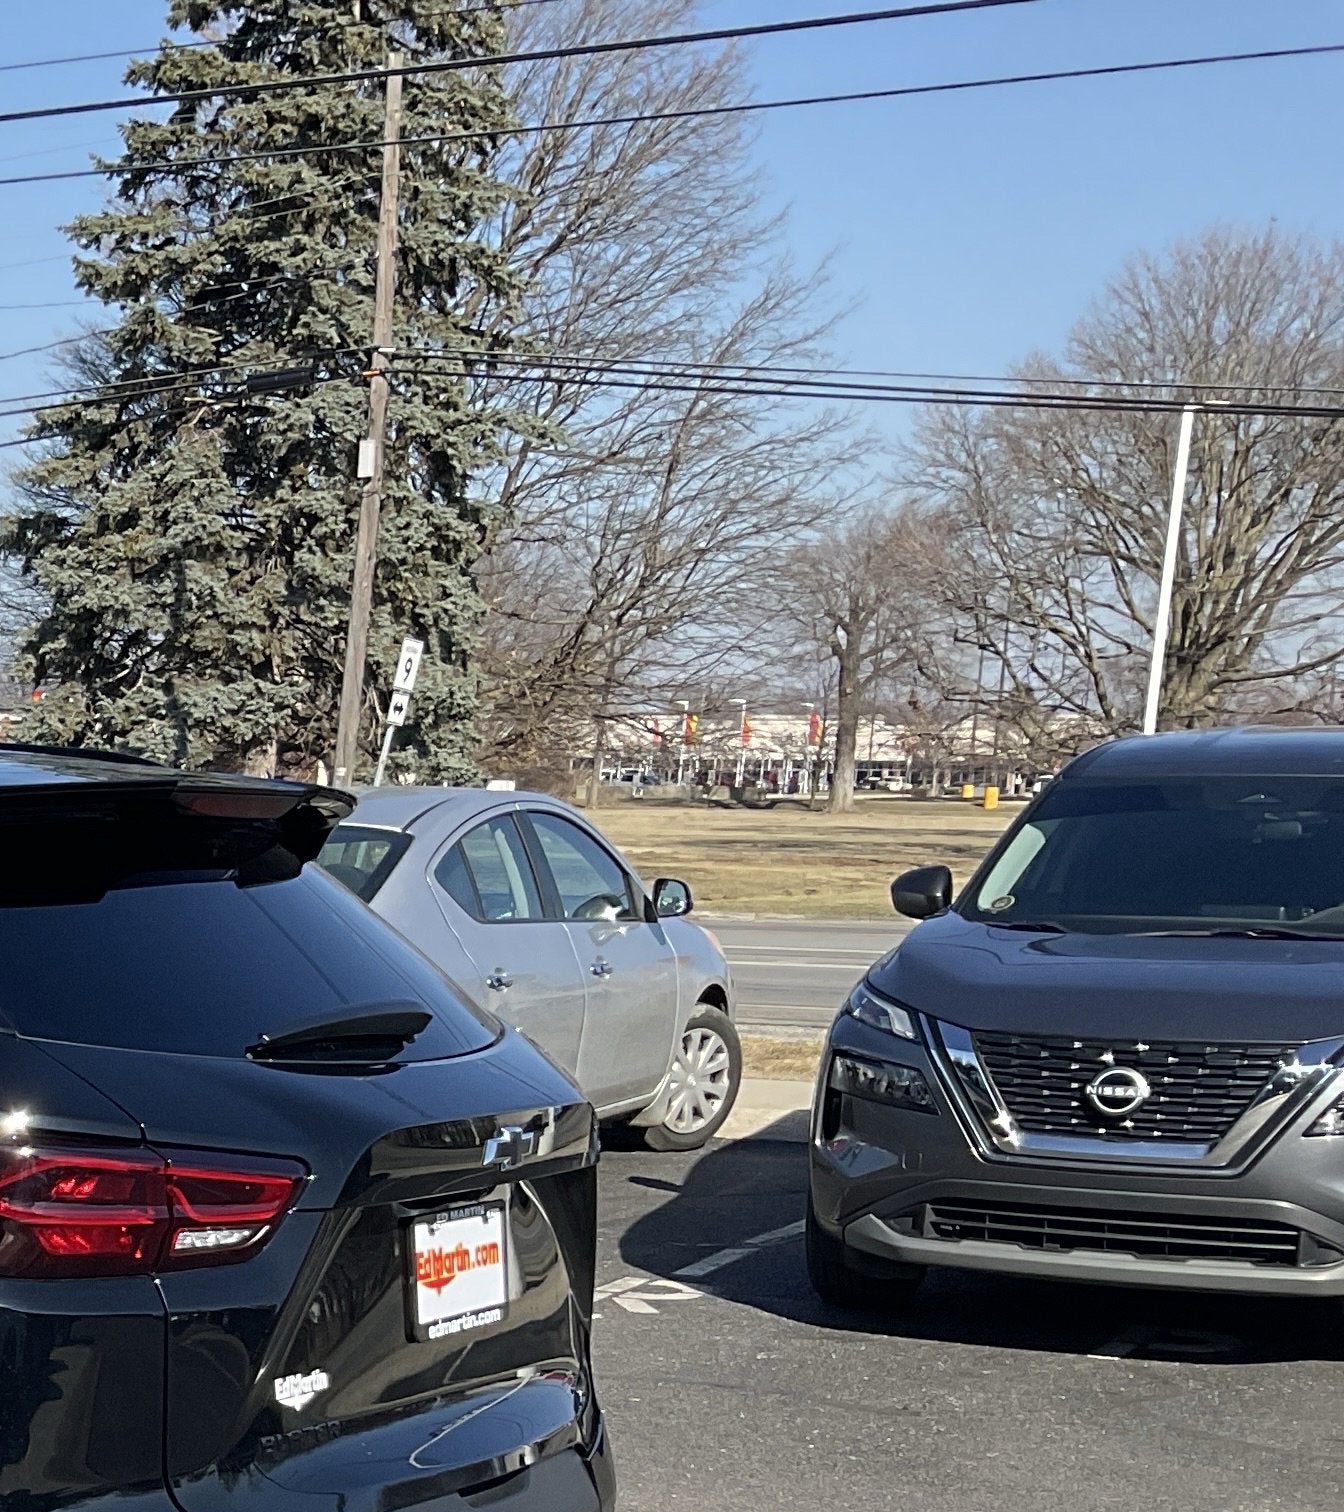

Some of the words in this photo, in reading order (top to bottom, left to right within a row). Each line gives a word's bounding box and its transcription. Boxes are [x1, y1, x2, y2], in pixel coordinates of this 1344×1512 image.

[404, 657, 413, 684] 9
[1086, 1085, 1151, 1098] NISSAN
[450, 1205, 485, 1219] MARTIN
[415, 1241, 500, 1282] EdMartin.com
[428, 1308, 502, 1340] edmartin.com
[274, 1368, 330, 1401] EdMartin
